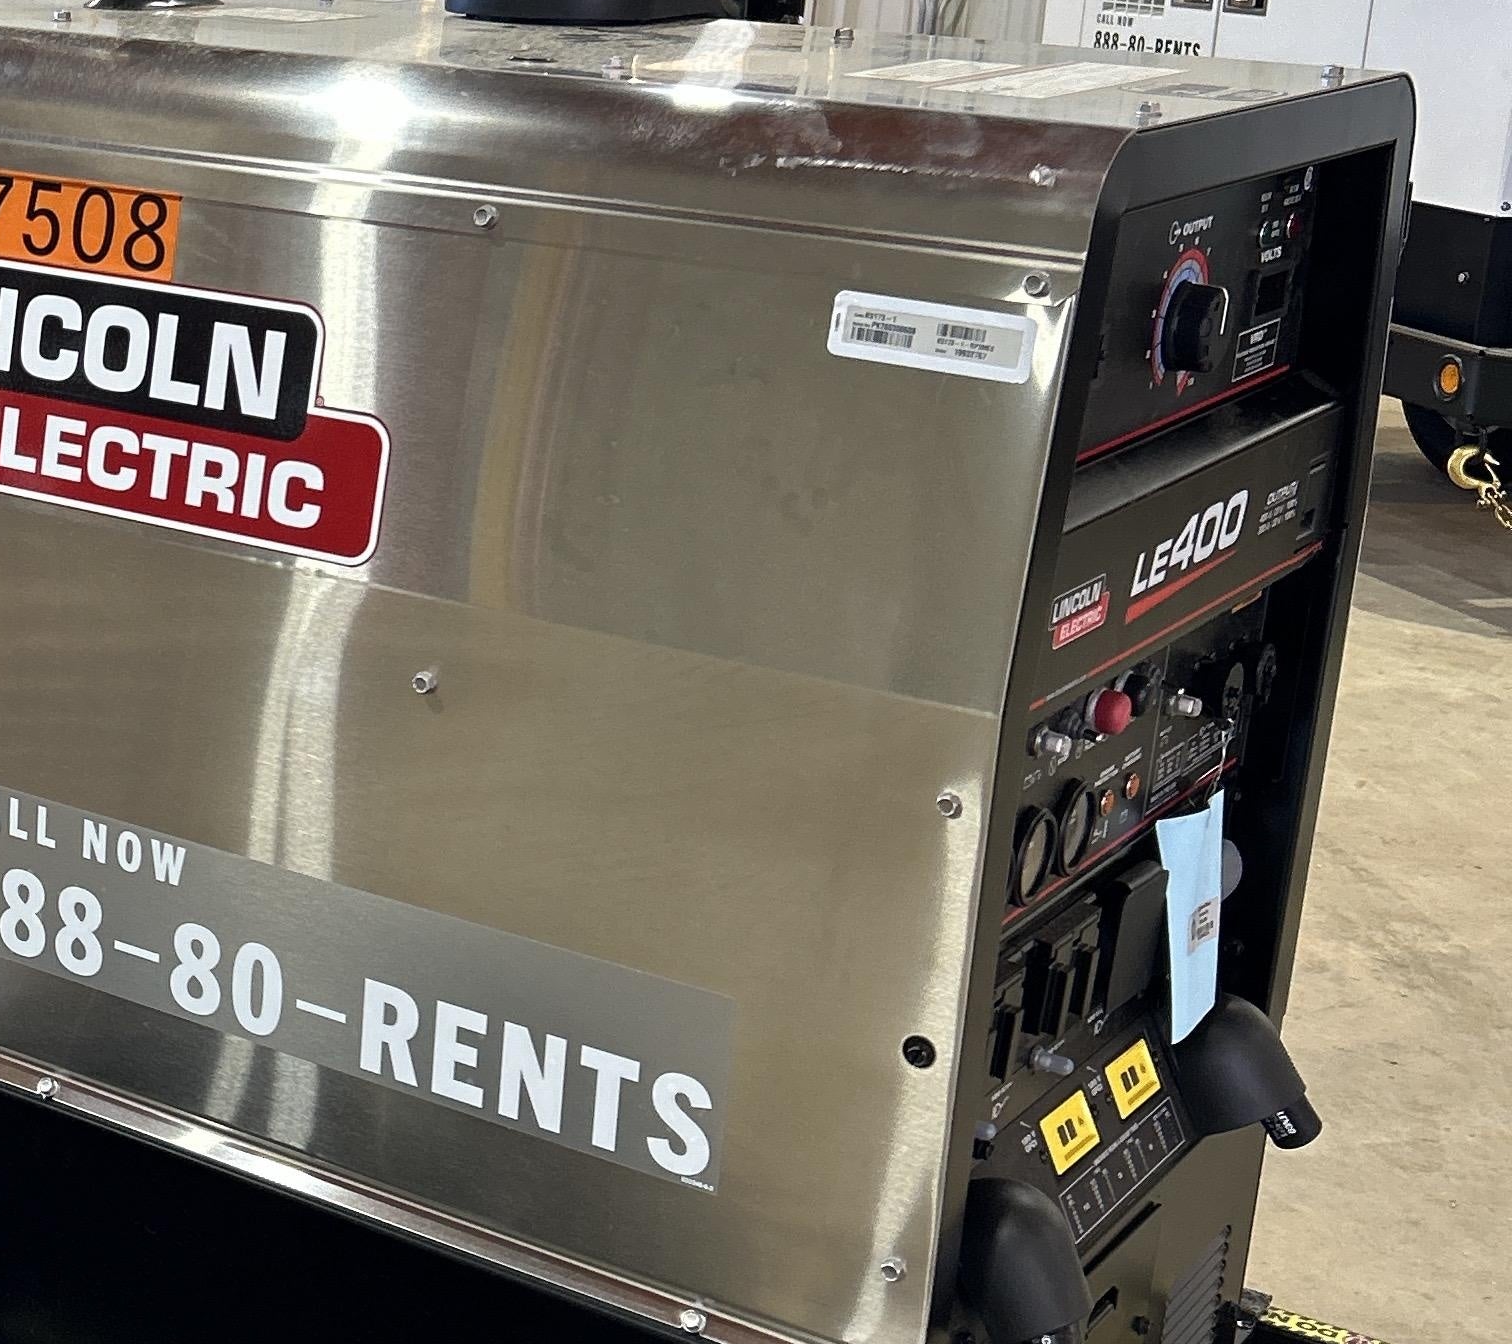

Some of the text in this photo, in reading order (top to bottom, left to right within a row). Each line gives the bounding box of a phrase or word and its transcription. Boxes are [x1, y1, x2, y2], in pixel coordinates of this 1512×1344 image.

[1130, 490, 1249, 598] LE400
[1052, 580, 1104, 624] LINCOLN
[82, 818, 187, 887] NOW
